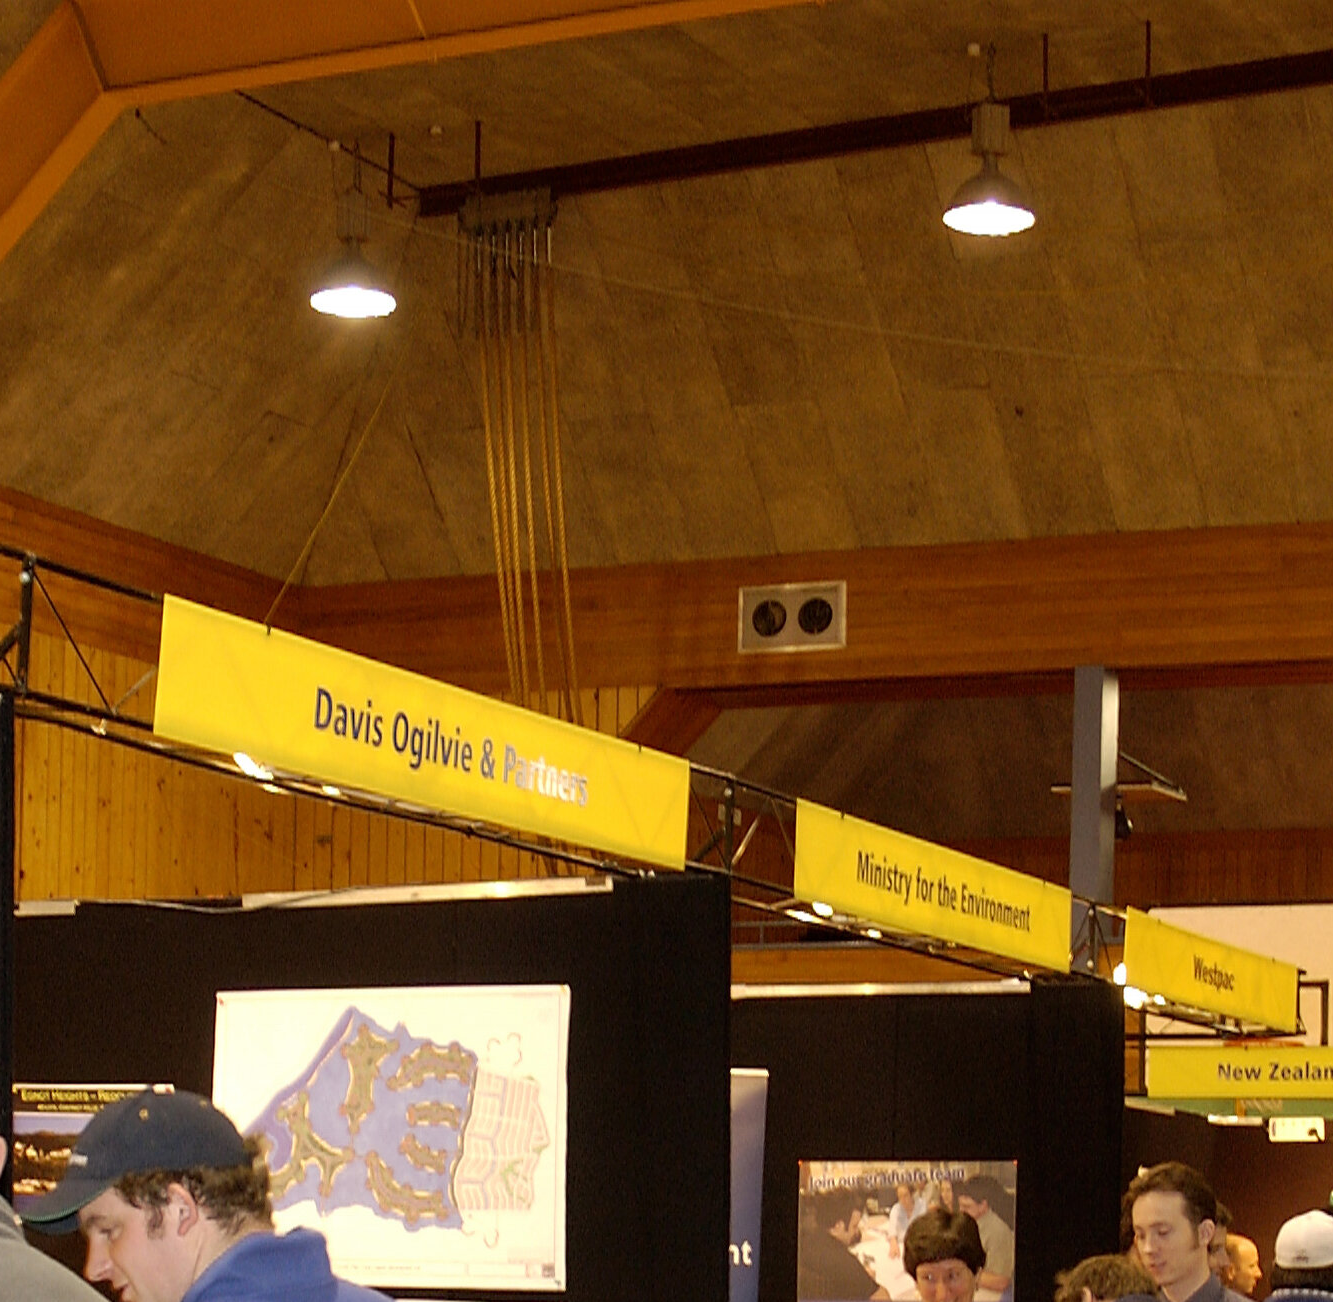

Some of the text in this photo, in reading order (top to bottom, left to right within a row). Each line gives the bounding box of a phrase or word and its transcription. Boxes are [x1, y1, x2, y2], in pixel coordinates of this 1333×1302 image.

[314, 687, 588, 807] Davis Ogilvie & Partners
[856, 850, 1031, 932] Ministry for the Environment
[1193, 954, 1235, 992] Westpac
[1217, 1063, 1261, 1081] New
